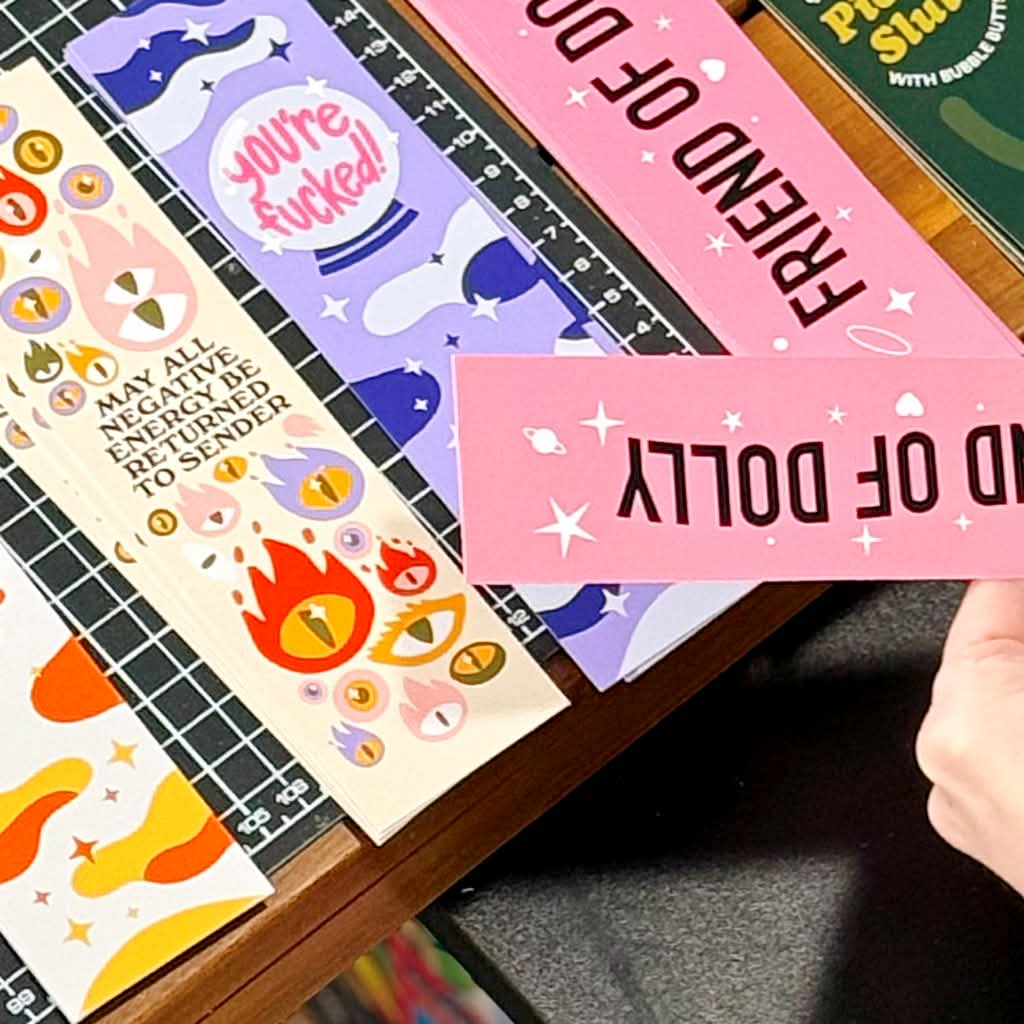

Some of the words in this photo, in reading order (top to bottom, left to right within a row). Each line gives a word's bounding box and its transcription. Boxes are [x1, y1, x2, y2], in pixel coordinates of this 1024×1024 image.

[590, 57, 701, 131] OF
[888, 70, 938, 88] WITH
[938, 40, 996, 84] BUBBLE
[453, 129, 477, 148] 10
[542, 225, 558, 240] 7
[672, 122, 868, 329] FRIEND
[637, 321, 652, 334] 4
[95, 367, 155, 418] MAY
[163, 337, 216, 376] ALL
[99, 346, 239, 441] NEGATIVE
[105, 383, 217, 464] ENERGY
[219, 359, 262, 390] BE
[122, 380, 270, 480] RETURNED
[133, 467, 176, 498] TO
[178, 394, 293, 472] SENDER
[856, 430, 939, 520] OF
[616, 436, 830, 528] DOLLY
